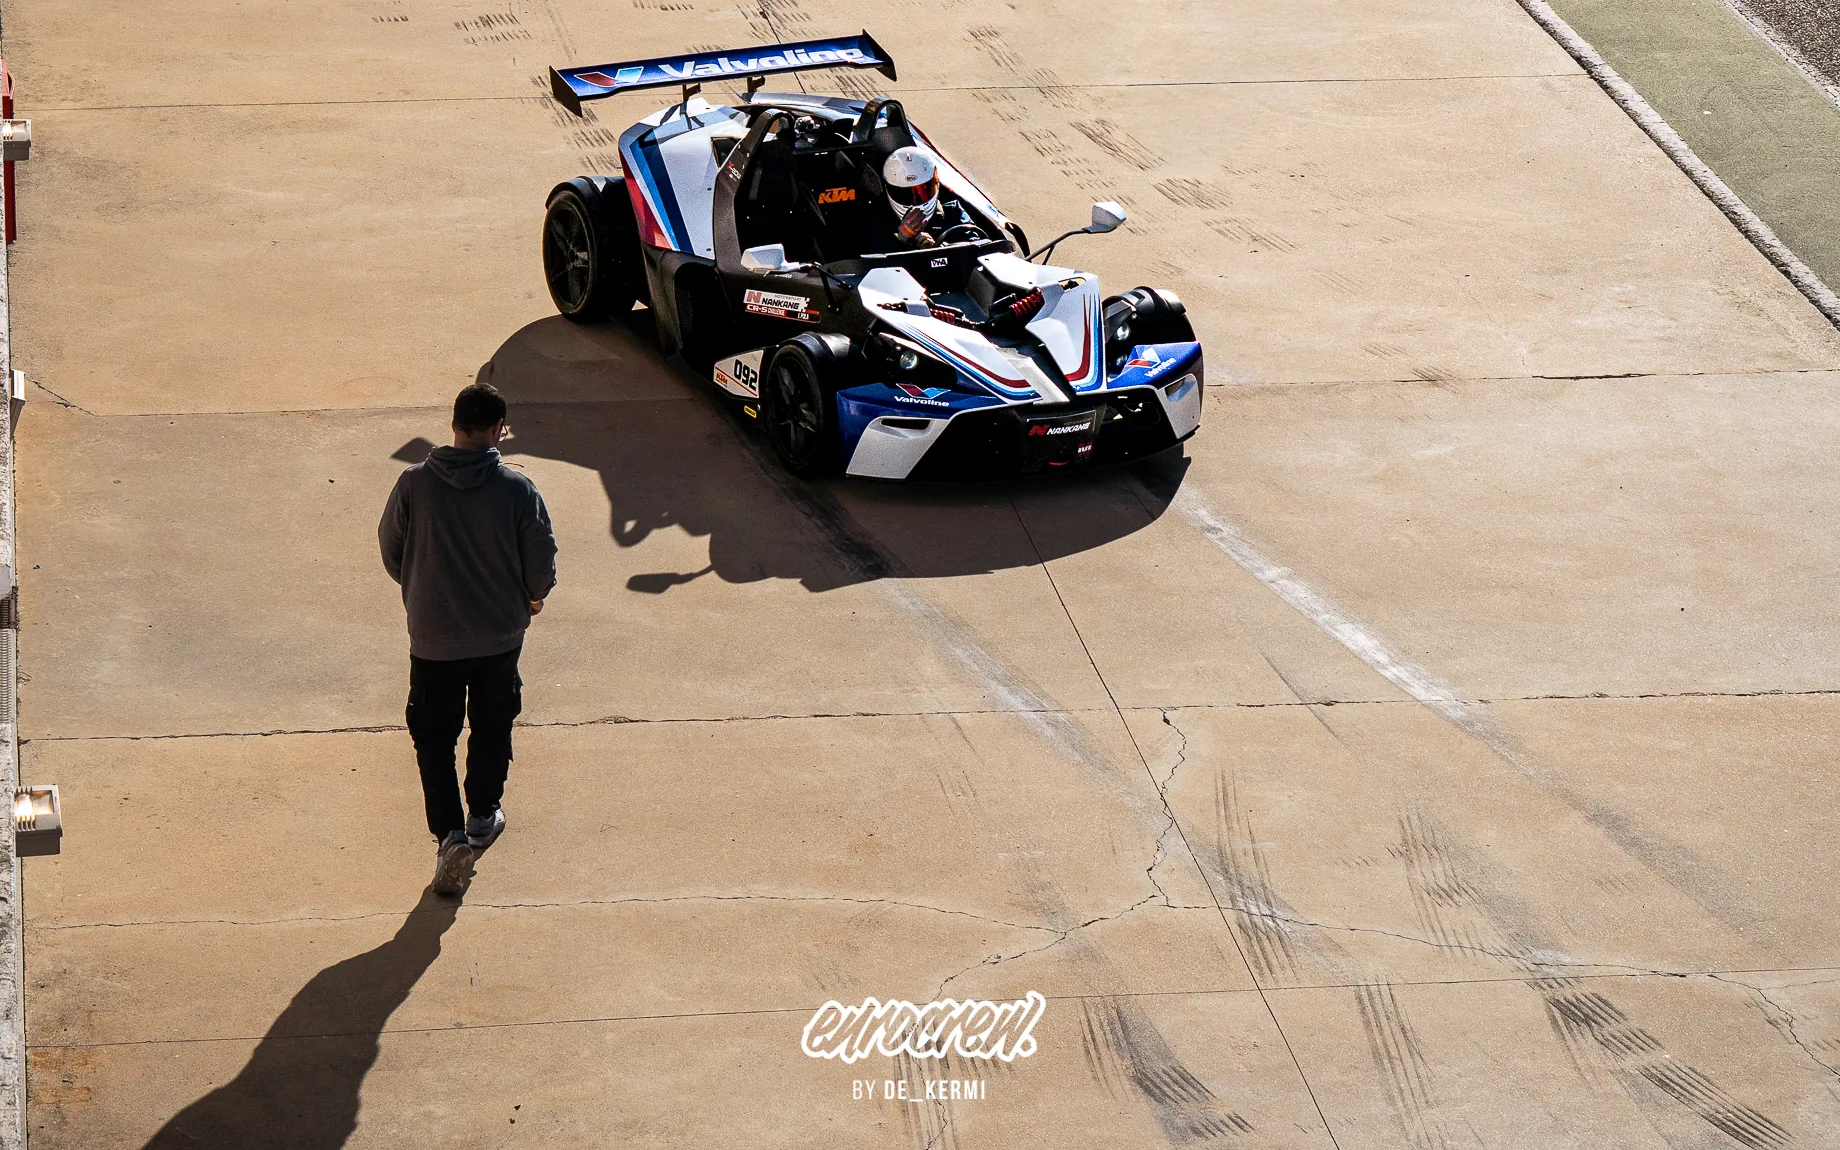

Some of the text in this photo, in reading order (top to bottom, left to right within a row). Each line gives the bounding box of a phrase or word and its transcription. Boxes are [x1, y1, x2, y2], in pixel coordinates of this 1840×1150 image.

[658, 47, 864, 78] Valvoline
[818, 187, 856, 204] KTM
[762, 298, 800, 310] NANKANG
[734, 358, 758, 391] 092
[1144, 358, 1177, 377] Valvoline
[894, 396, 950, 407] Valvoline
[1046, 421, 1091, 435] NANKANG
